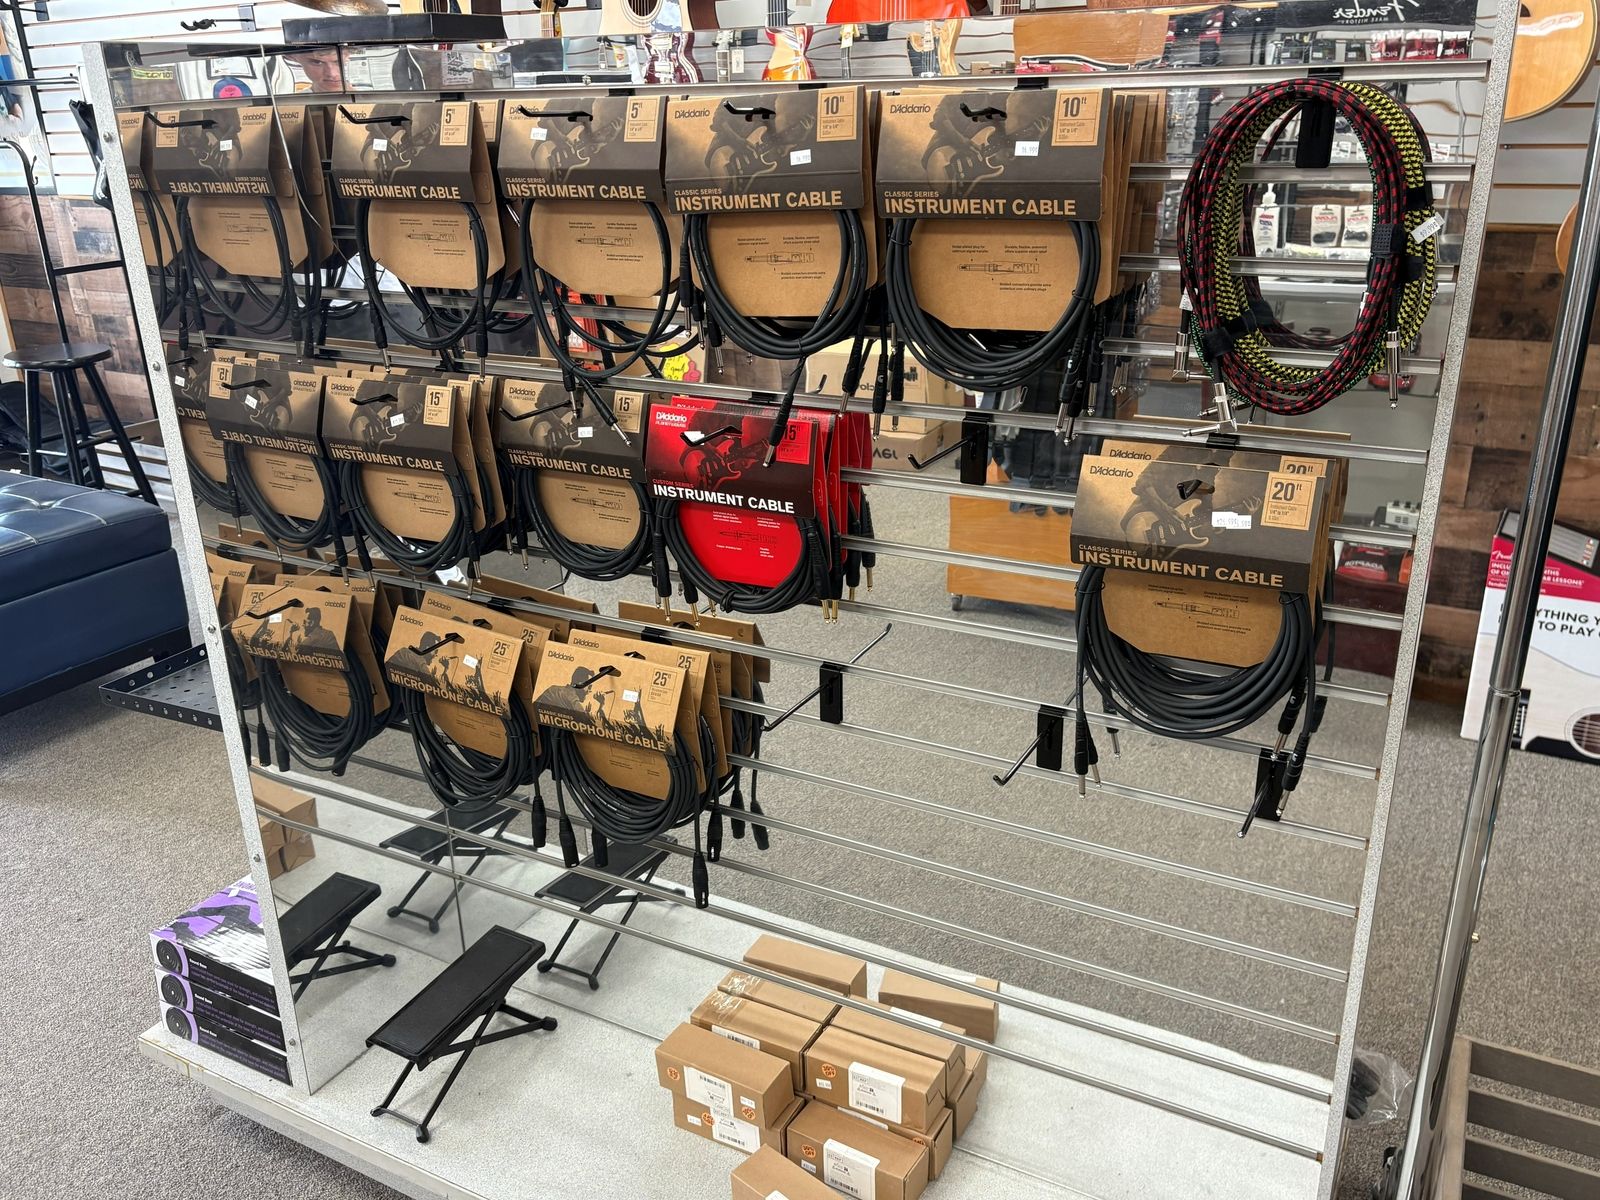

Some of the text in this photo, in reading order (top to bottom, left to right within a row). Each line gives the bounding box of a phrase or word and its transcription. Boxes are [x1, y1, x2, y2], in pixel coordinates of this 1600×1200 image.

[674, 108, 711, 119] D'Addario
[889, 103, 931, 114] D'Addario
[340, 184, 461, 199] INSTRUMENT CABLE
[507, 184, 647, 199] INSTRUMENT CABLE
[675, 190, 843, 211] INSTRUMENT CABLE
[885, 198, 1077, 216] INSTRUMENT CABLE
[509, 386, 536, 397] D'Addario
[656, 411, 687, 423] D'Addario
[331, 448, 445, 472] INSTRUMENT CABLE
[1109, 448, 1152, 461] D'Addario
[510, 453, 632, 479] INSTRUMENT CABLE
[1089, 465, 1134, 478] D'Addario
[652, 478, 695, 488] CUSTOM SERIES
[653, 483, 744, 507] INSTRUMENT
[748, 497, 795, 514] CABLE
[1078, 544, 1138, 557] CLASSIC SERIES
[1079, 550, 1284, 588] INSTRUMENT CABLE
[1491, 562, 1511, 570] INCLU
[1536, 609, 1589, 624] YTHING
[1538, 620, 1595, 635] TO PLAY
[390, 673, 503, 716] MICROPHONE CABLE
[539, 714, 666, 753] MICROPHONE CABLE
